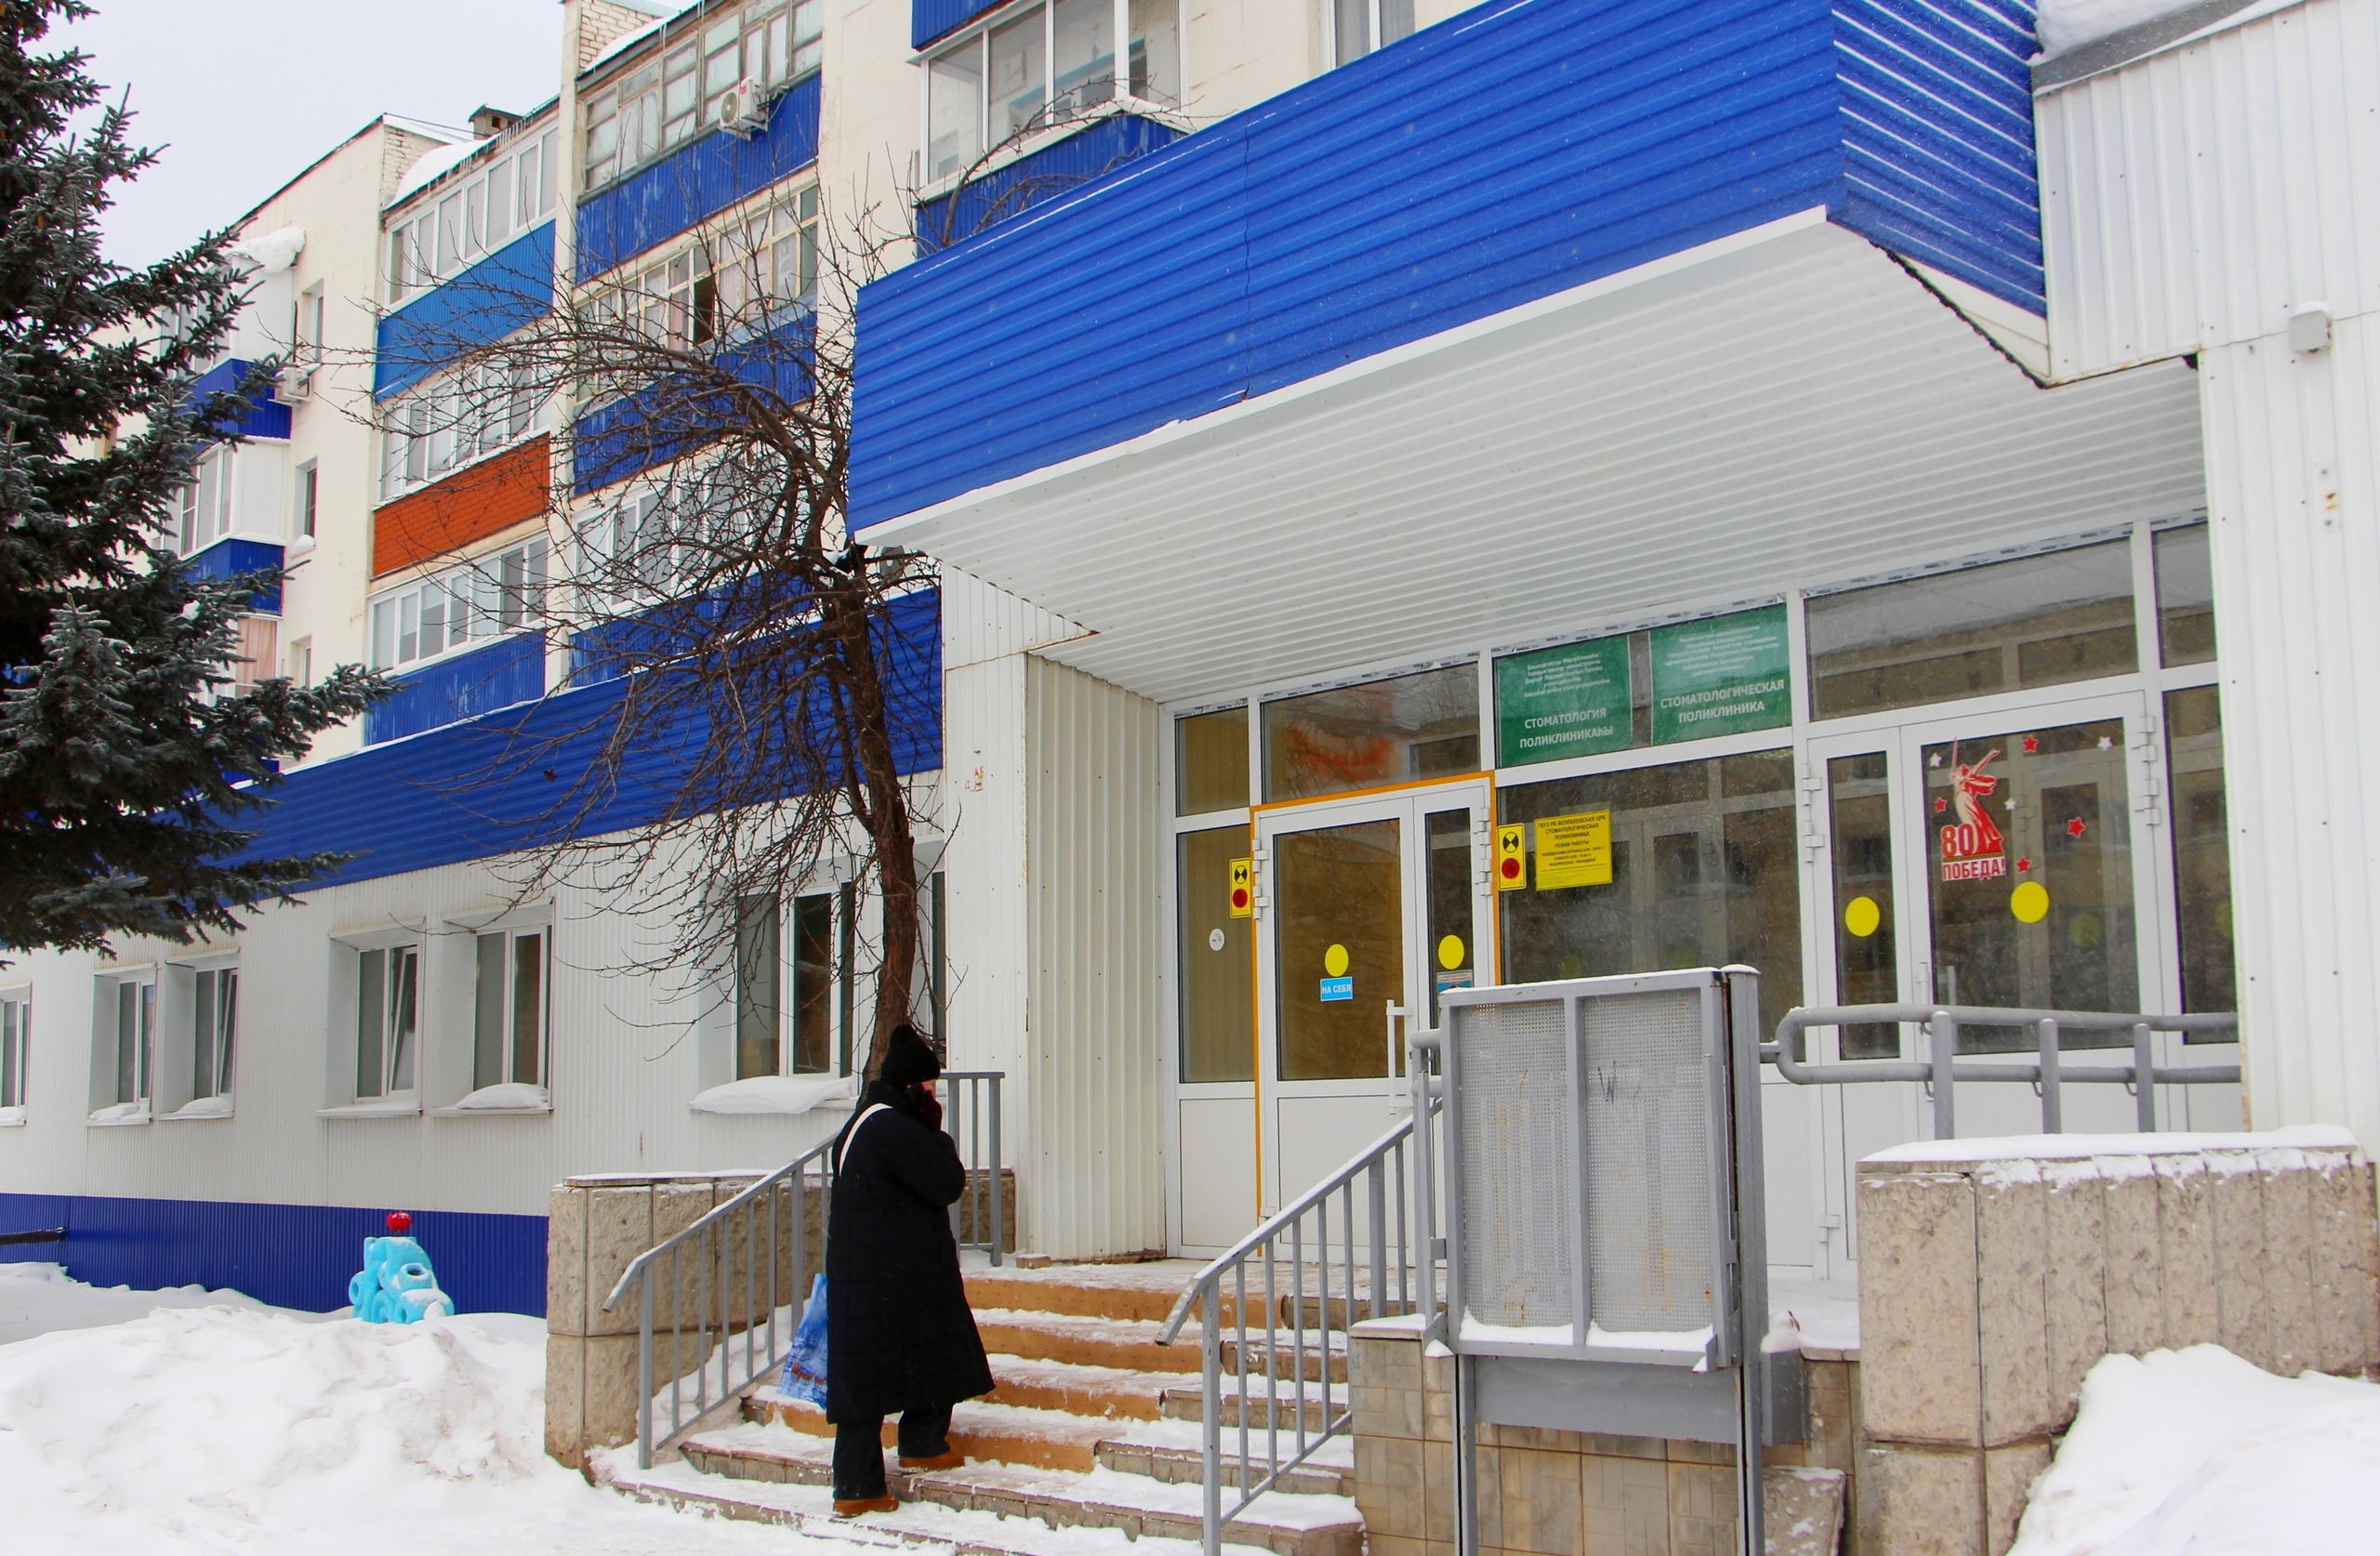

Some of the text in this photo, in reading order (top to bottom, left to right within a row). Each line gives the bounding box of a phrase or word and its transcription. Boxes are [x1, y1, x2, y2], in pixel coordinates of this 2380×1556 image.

[1660, 679, 1785, 709] СТОМАТОЛОГИЧЕСКАЯ
[1525, 707, 1607, 729] СТОМАТОЛОГИЯ
[1678, 701, 1765, 723] ПОЛИКЛИНИКА
[1941, 824, 1974, 857] 80
[1942, 858, 2006, 880] ПОБЕДА!
[1322, 983, 1352, 994] НА СЕБЯ
